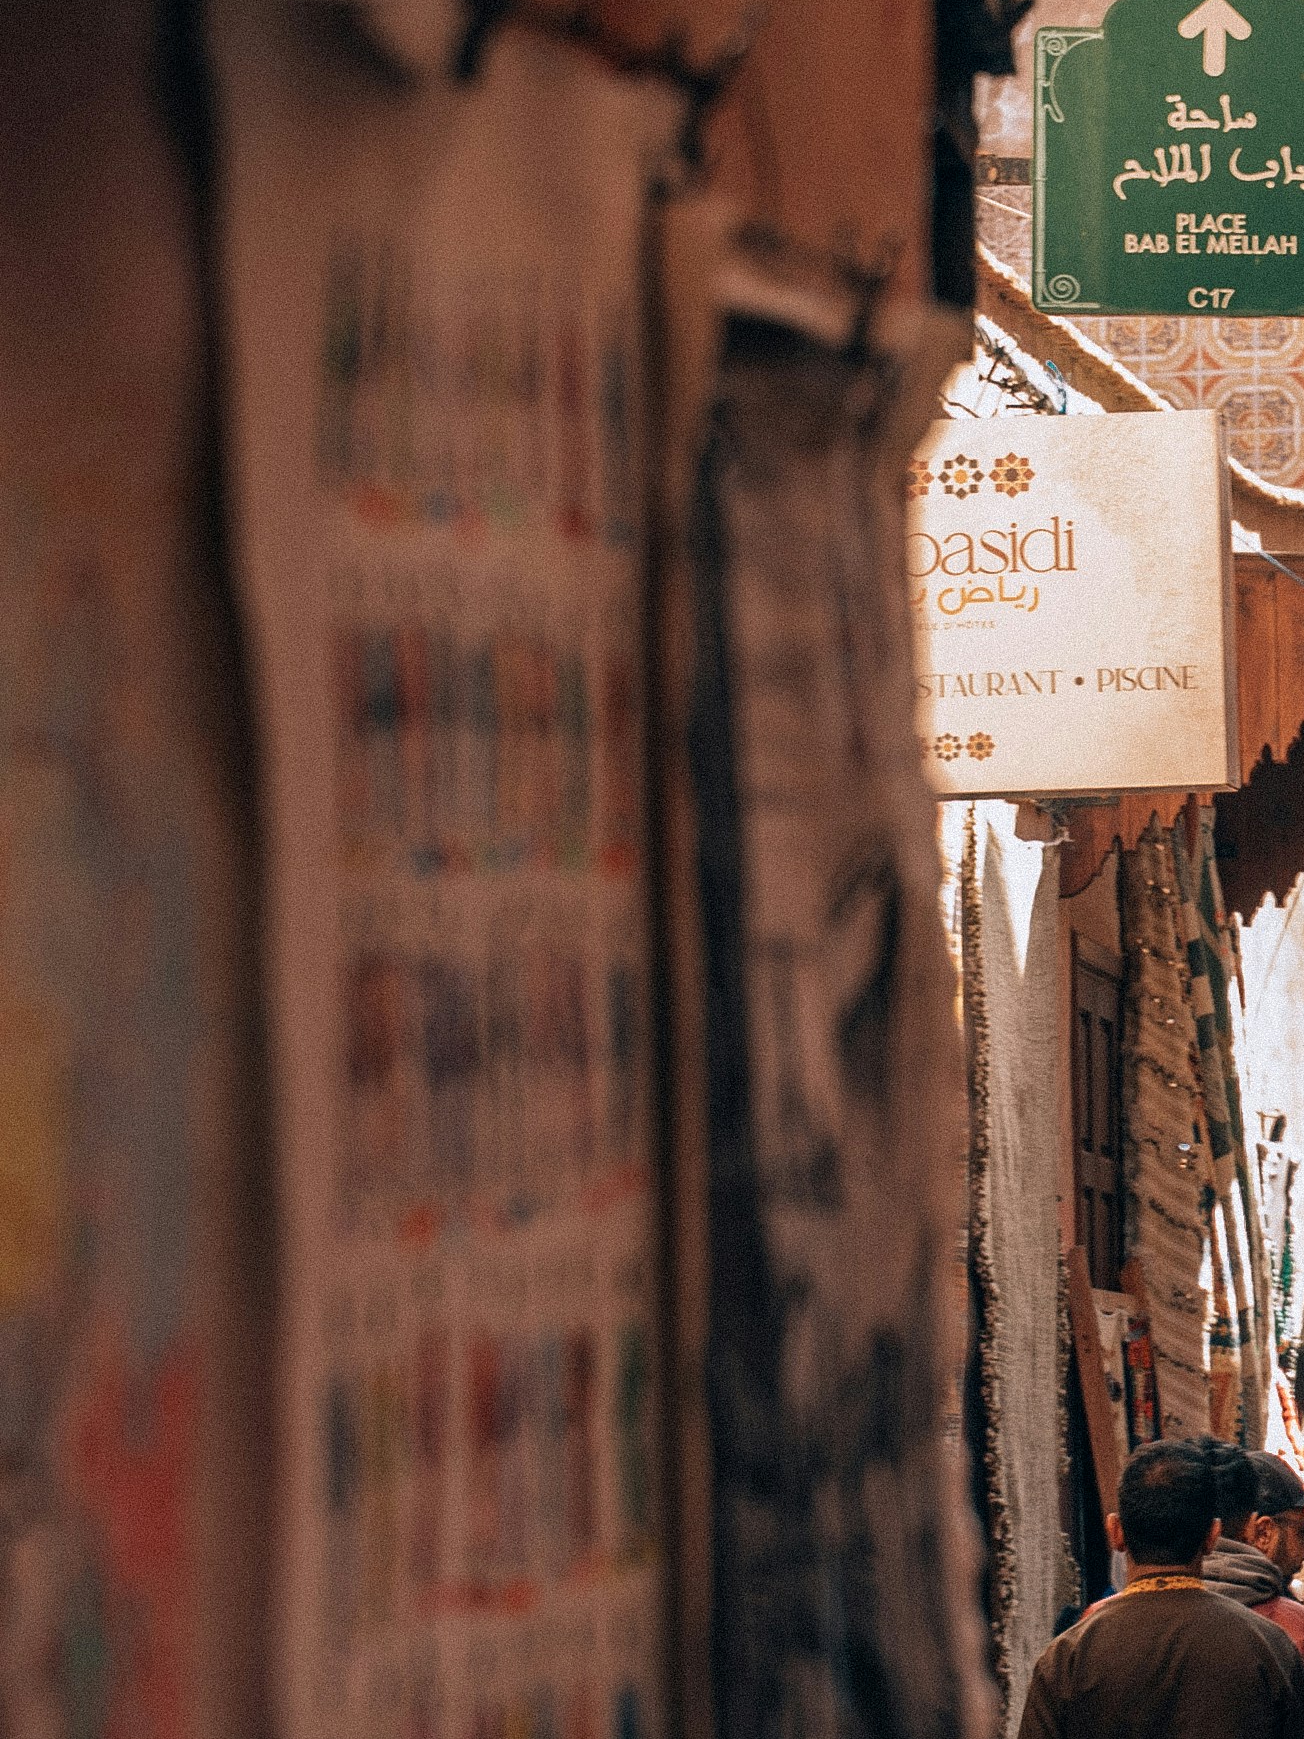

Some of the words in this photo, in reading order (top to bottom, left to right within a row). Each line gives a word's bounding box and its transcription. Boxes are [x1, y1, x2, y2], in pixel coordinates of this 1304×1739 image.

[1165, 94, 1257, 133] ساحة
[1112, 142, 1212, 201] الملاح
[1175, 213, 1246, 234] PLACE
[1124, 234, 1170, 254] BAB
[1175, 234, 1201, 255] EL
[1206, 235, 1298, 256] MELLAH
[1187, 287, 1236, 310] C17
[937, 575, 1040, 616] رياض
[917, 669, 1064, 699] STAURANT
[1096, 664, 1200, 694] PISCINE
